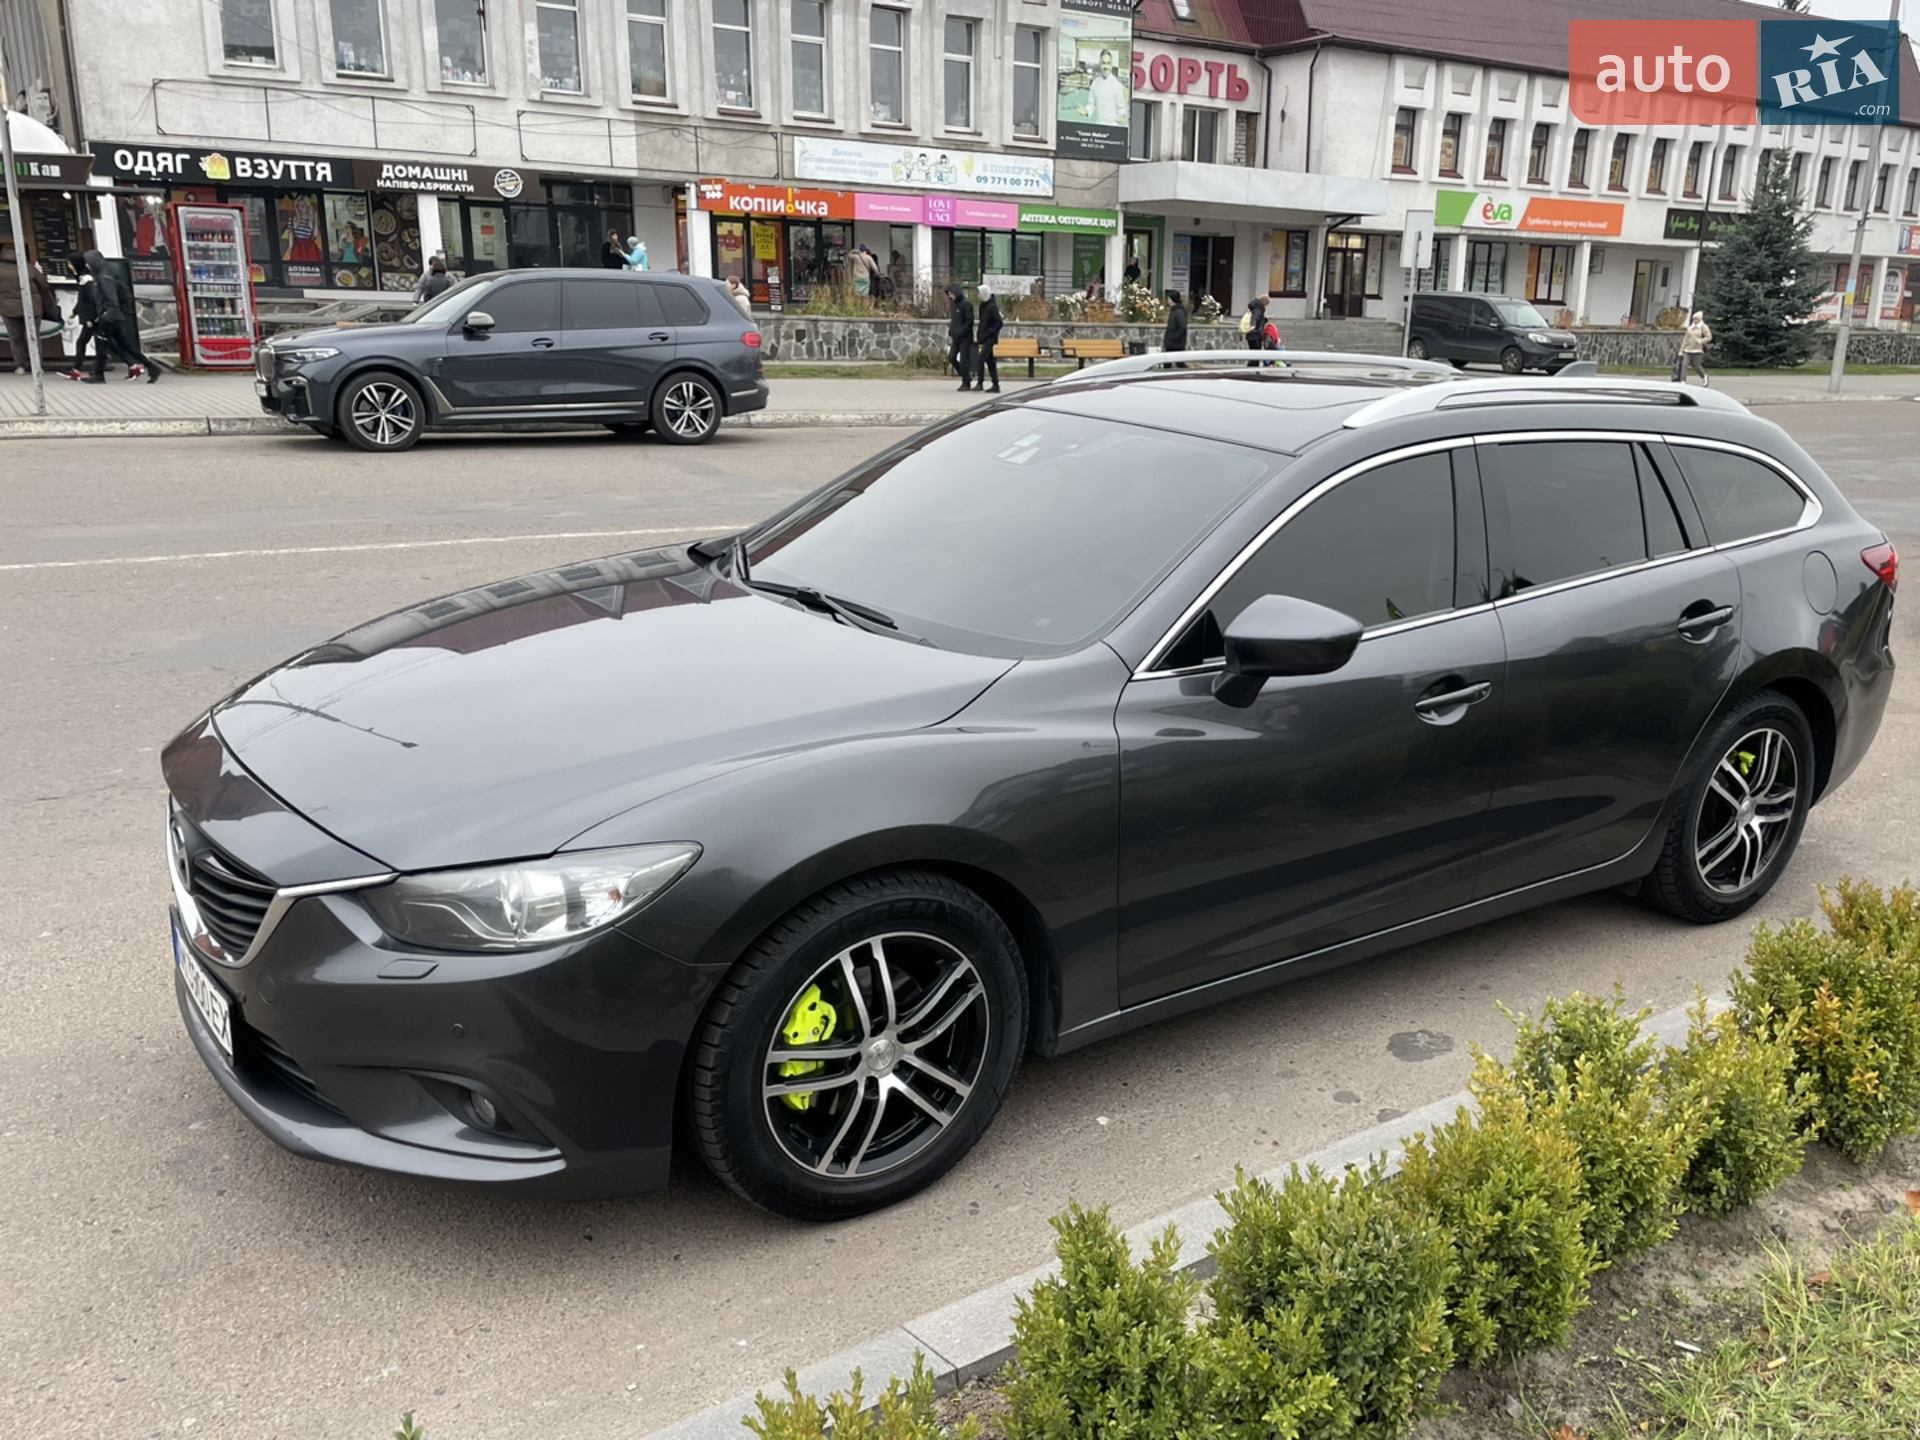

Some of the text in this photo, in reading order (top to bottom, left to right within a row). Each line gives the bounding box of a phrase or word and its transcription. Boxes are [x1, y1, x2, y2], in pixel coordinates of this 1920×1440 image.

[114, 149, 333, 183] ОДЯГ ВЗУТТЯ
[381, 164, 468, 181] ДОМАШНІ
[376, 178, 474, 193] НАПІВФАБРИКАТИ
[975, 174, 1041, 187] 09 771 00 771
[928, 199, 952, 210] LOVE
[928, 211, 952, 223] LACE
[1021, 213, 1116, 228] АПТЕКА ОПТОВИХ ЦІН
